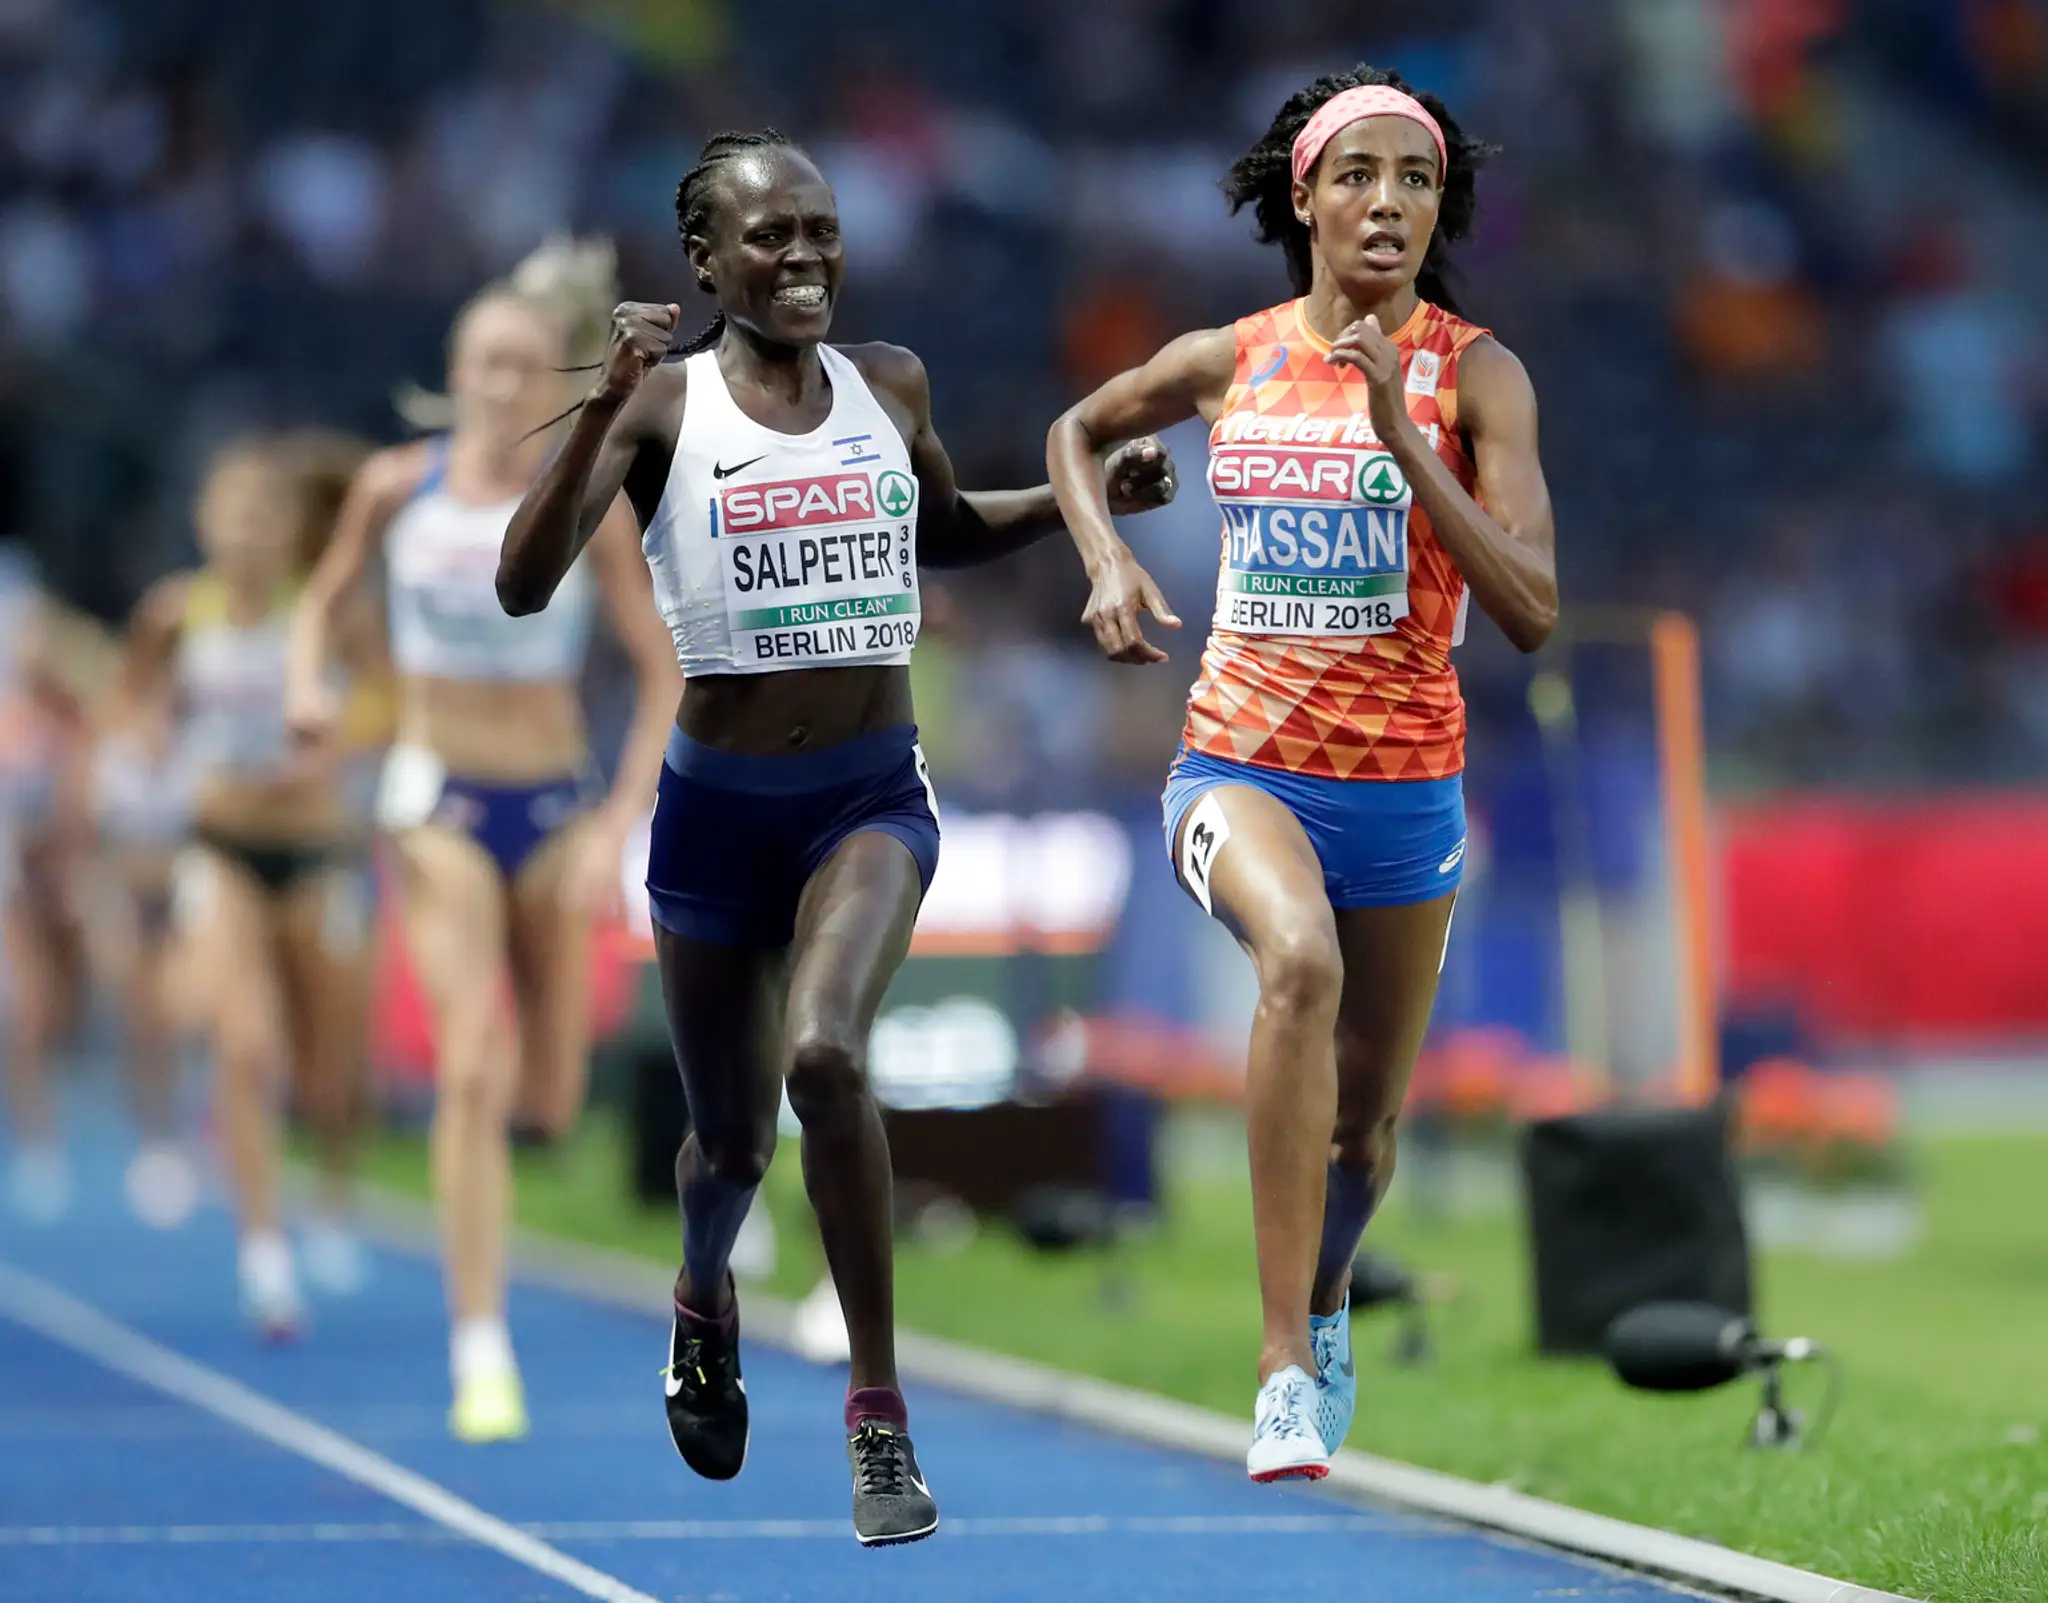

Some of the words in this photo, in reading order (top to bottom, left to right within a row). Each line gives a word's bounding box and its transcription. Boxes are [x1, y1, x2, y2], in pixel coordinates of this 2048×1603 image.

[1215, 456, 1350, 494] SPAR
[726, 479, 871, 527] SPAR
[1225, 507, 1397, 569] HASSAN
[733, 531, 894, 592] SALPETER
[1243, 578, 1247, 591] I
[1252, 577, 1291, 593] RUN
[779, 609, 785, 624] I
[790, 604, 829, 623] RUN
[1231, 599, 1314, 629] BERLIN
[1325, 602, 1393, 630] 2018
[755, 626, 857, 659] BERLIN
[864, 620, 915, 650] 2018
